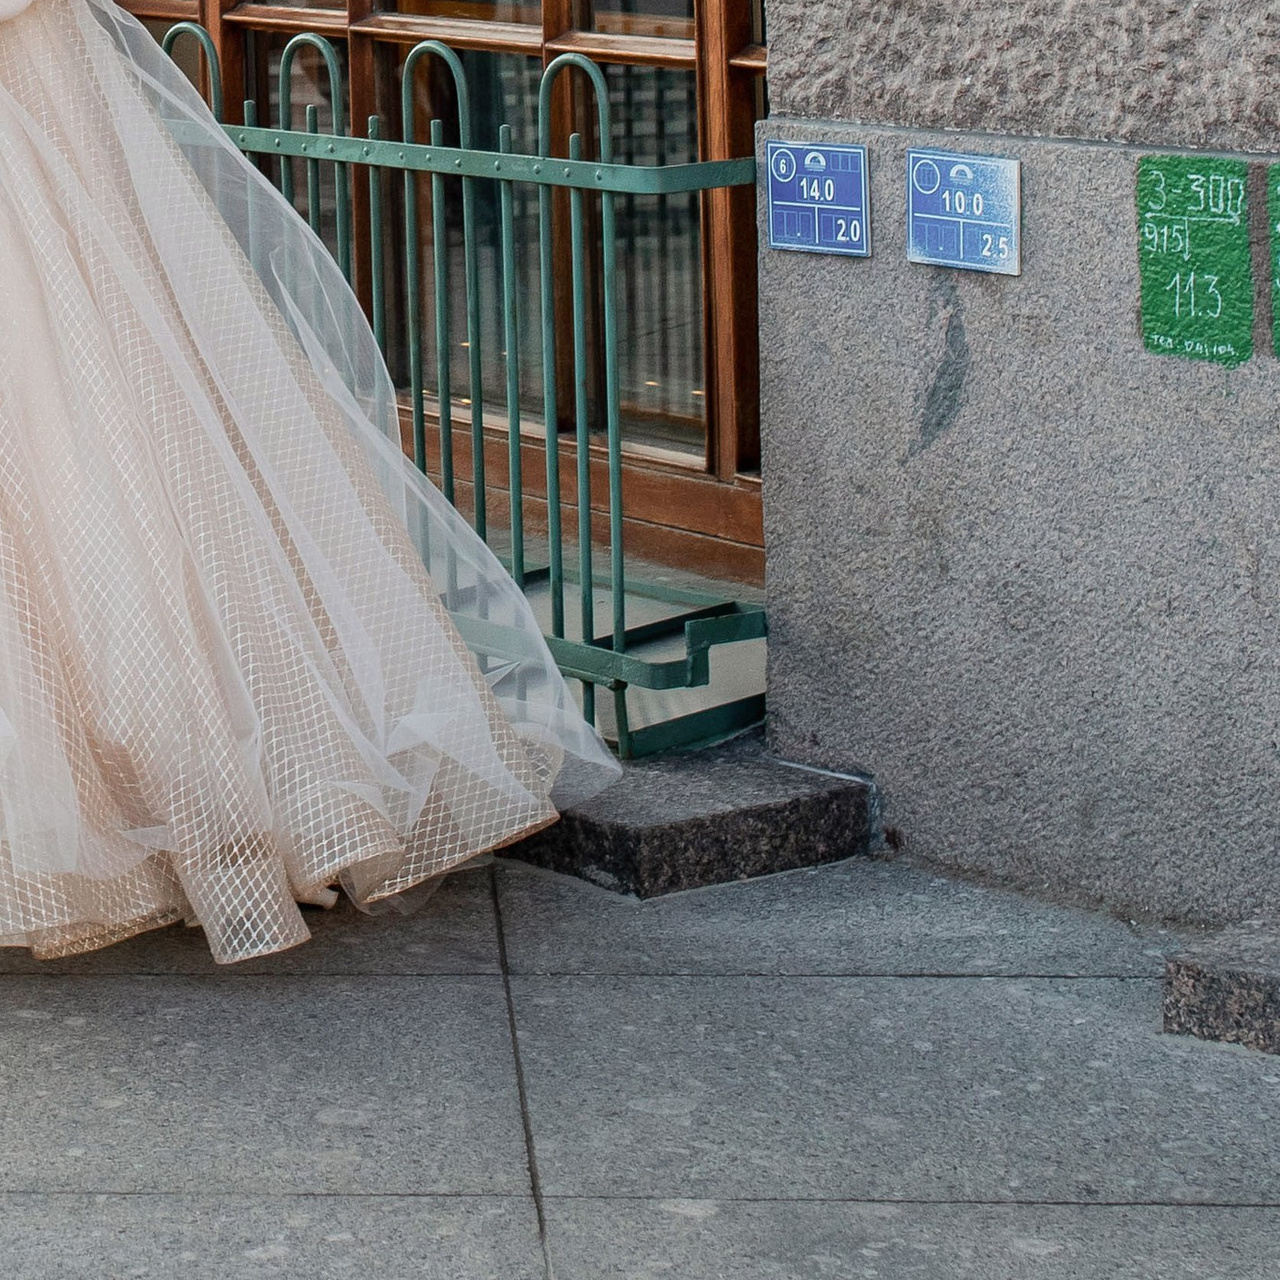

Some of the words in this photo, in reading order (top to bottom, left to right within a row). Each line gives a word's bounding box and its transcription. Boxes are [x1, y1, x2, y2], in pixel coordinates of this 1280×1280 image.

[779, 158, 787, 174] 6
[800, 177, 835, 201] 14.0
[942, 189, 983, 216] 10.0
[836, 219, 860, 242] 2.0
[982, 233, 1009, 259] 2.5
[1165, 271, 1222, 318] 11.3
